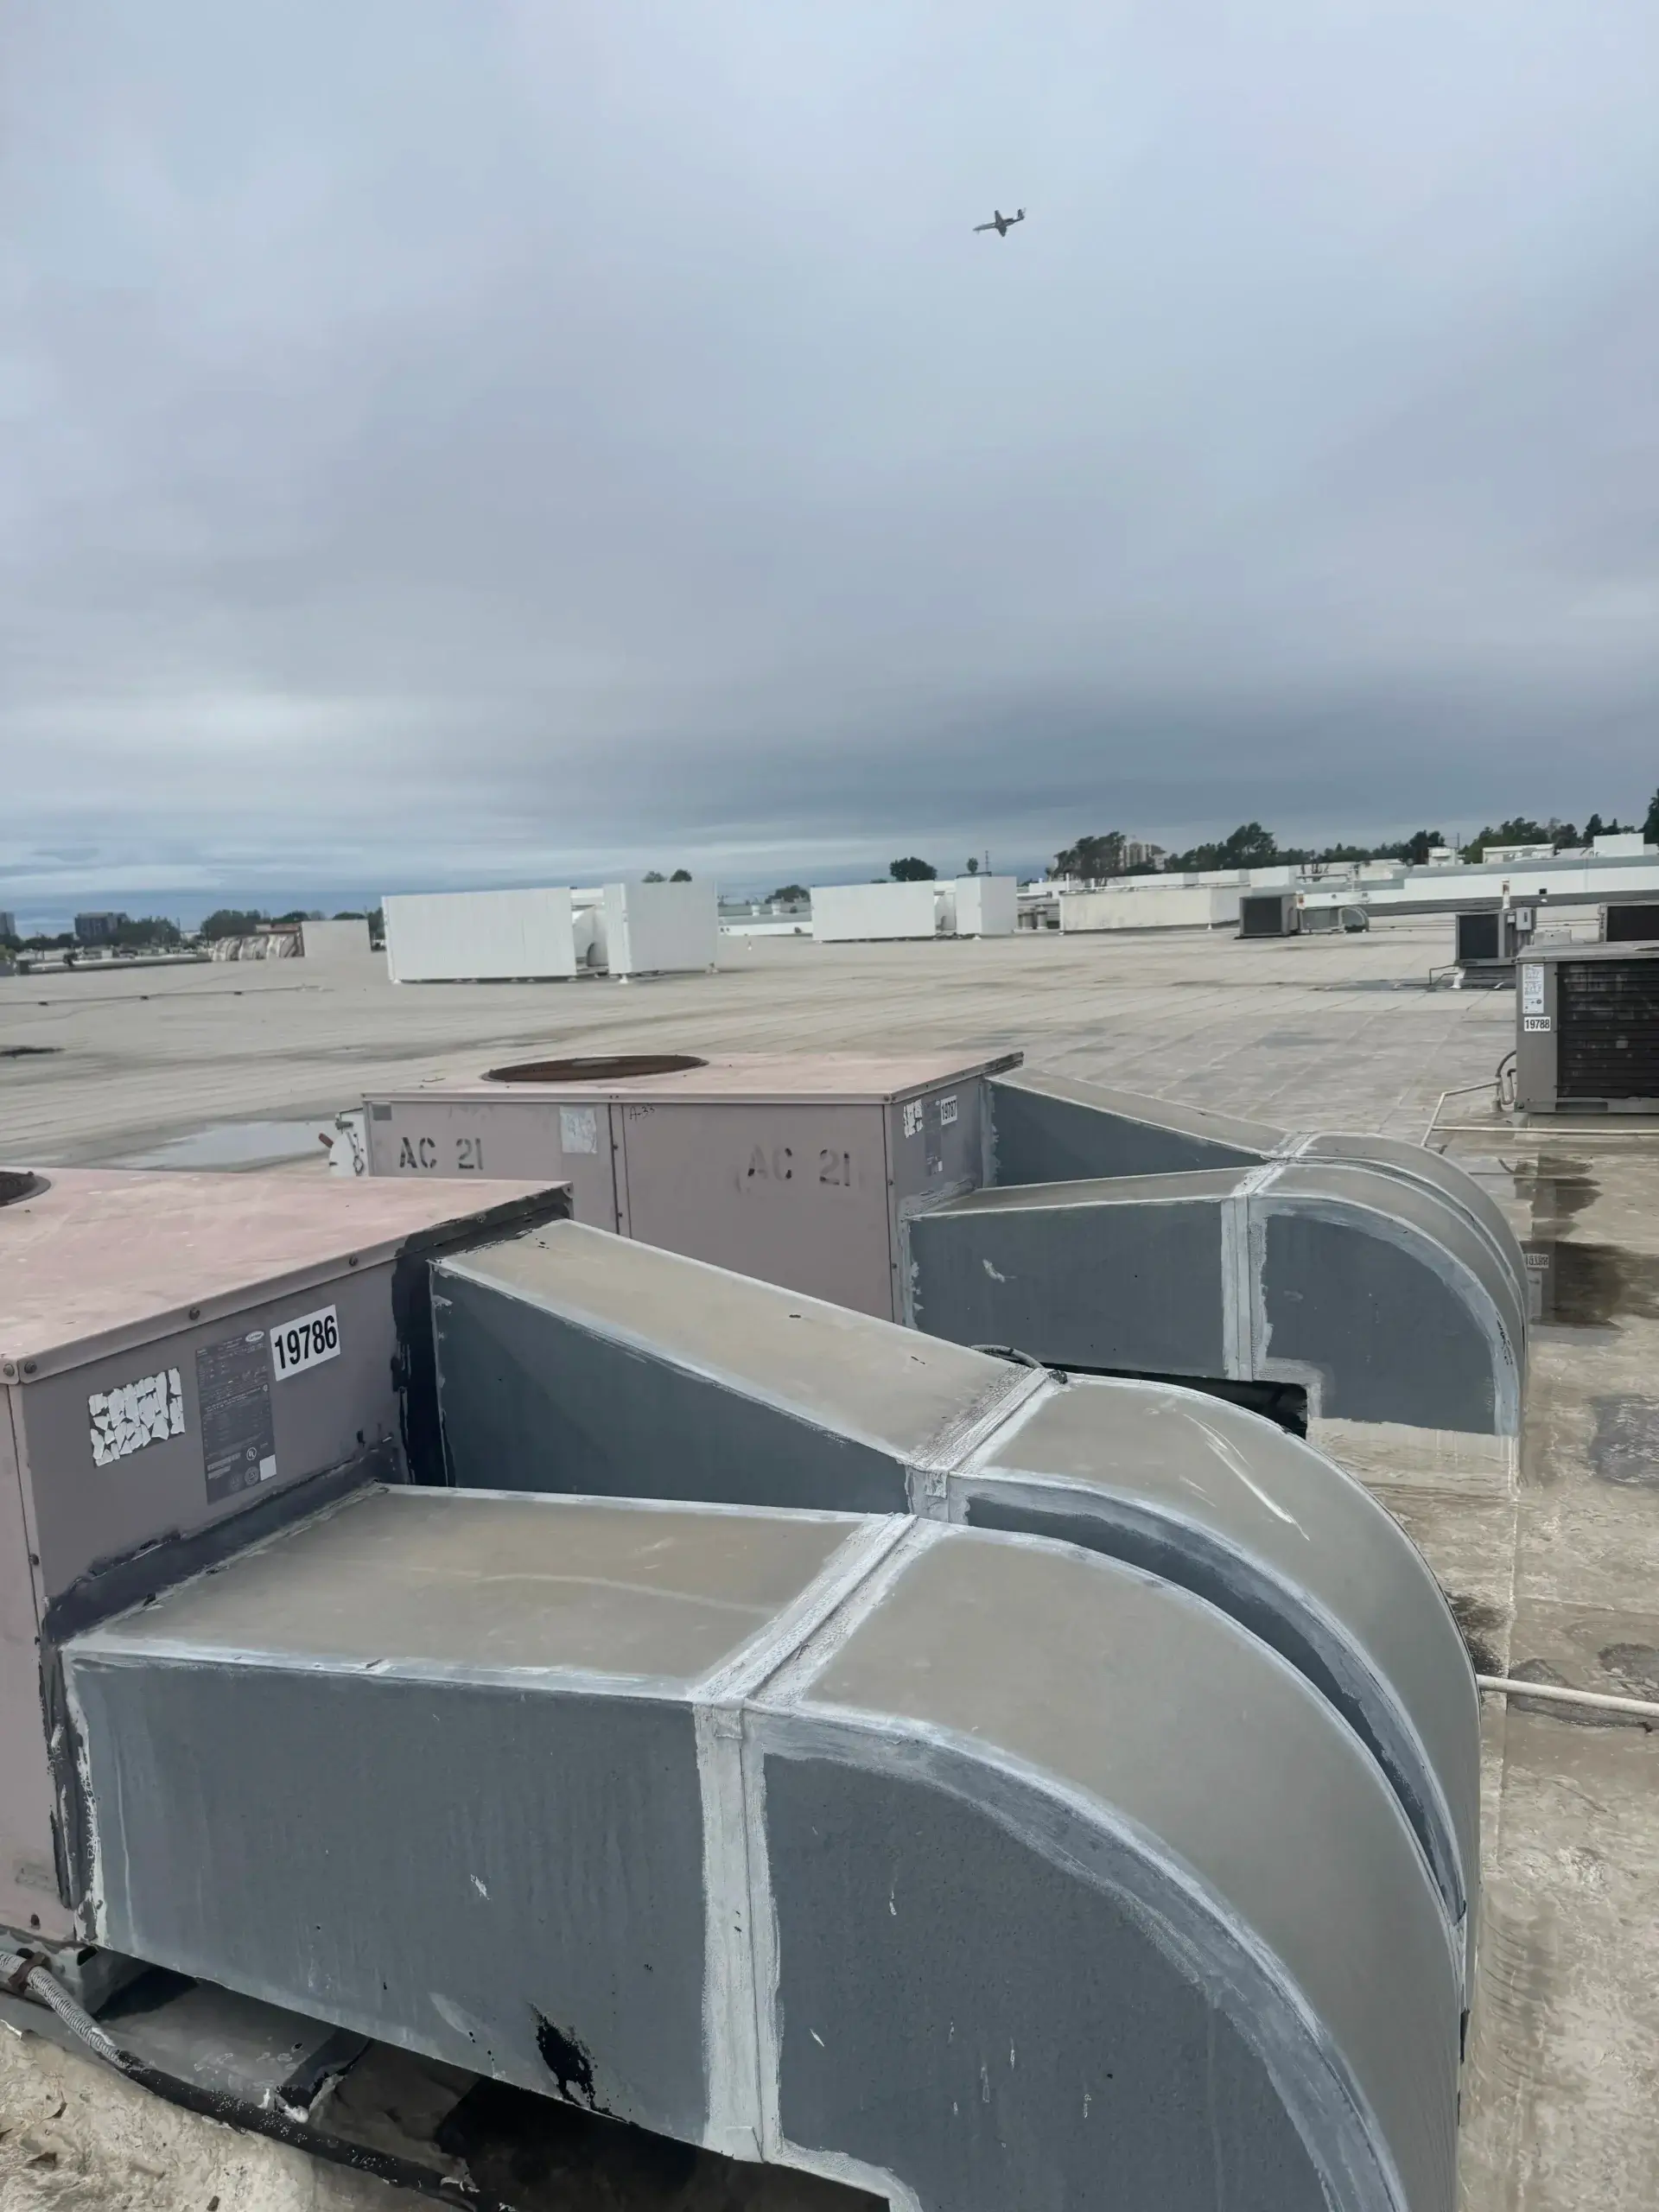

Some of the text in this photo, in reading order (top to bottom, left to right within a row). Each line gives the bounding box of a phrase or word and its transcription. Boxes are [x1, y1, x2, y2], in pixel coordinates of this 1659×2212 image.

[1525, 1019, 1550, 1029] 19788
[399, 1136, 484, 1171] AC 21
[747, 1144, 851, 1186] AC 21
[274, 1314, 338, 1370] 19786
